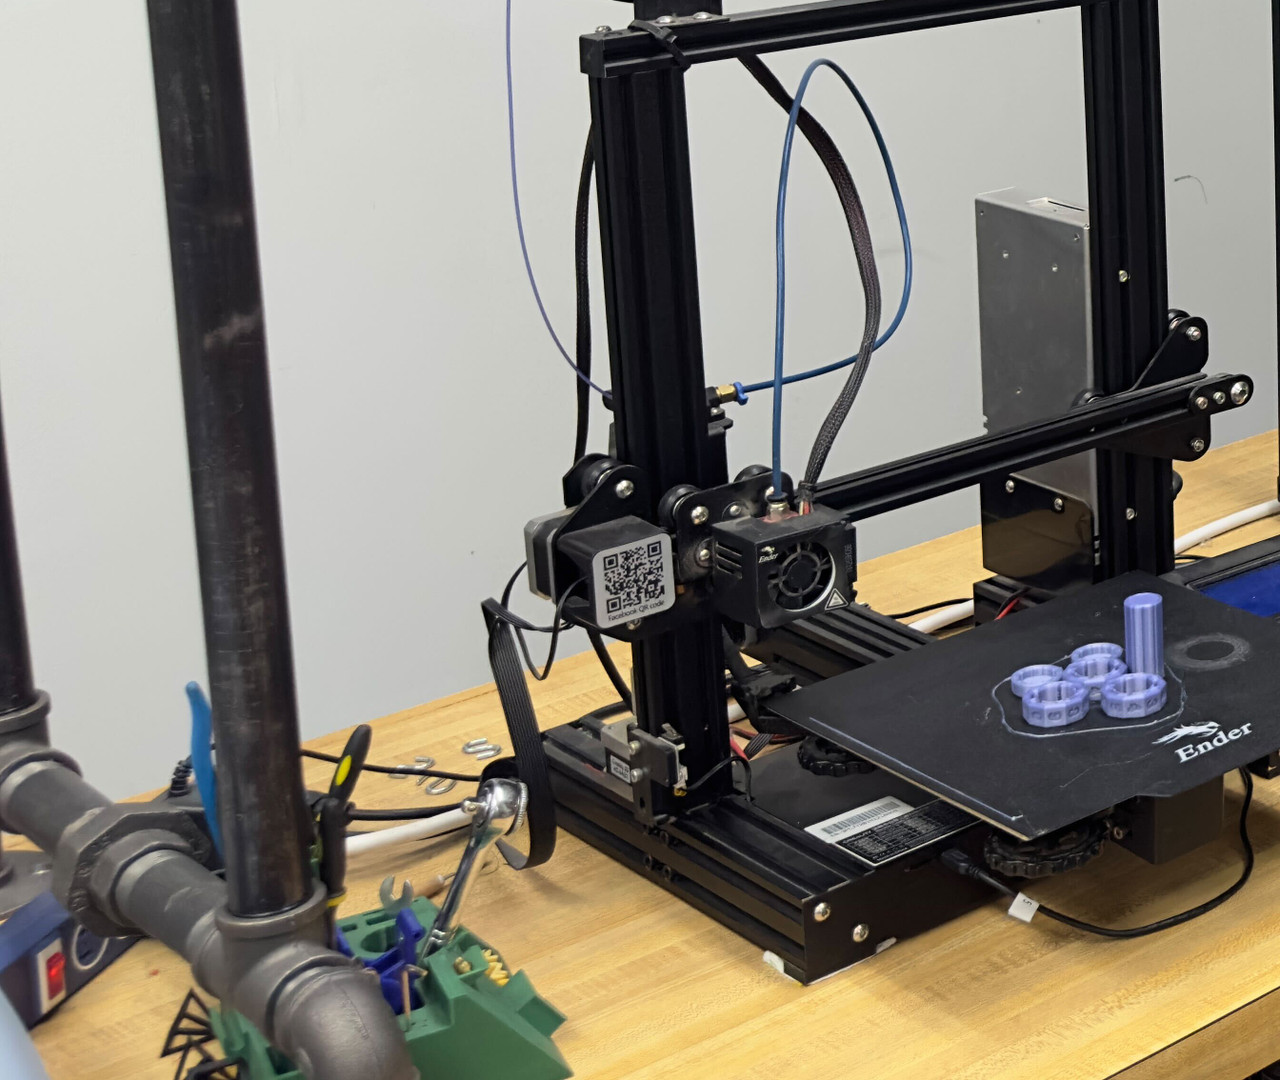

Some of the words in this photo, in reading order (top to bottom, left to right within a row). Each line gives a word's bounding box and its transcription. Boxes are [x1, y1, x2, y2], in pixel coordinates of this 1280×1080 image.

[758, 552, 779, 564] Ender
[607, 607, 637, 622] Facebook
[638, 604, 650, 613] QR
[650, 599, 665, 609] code
[1174, 722, 1253, 763] Ender
